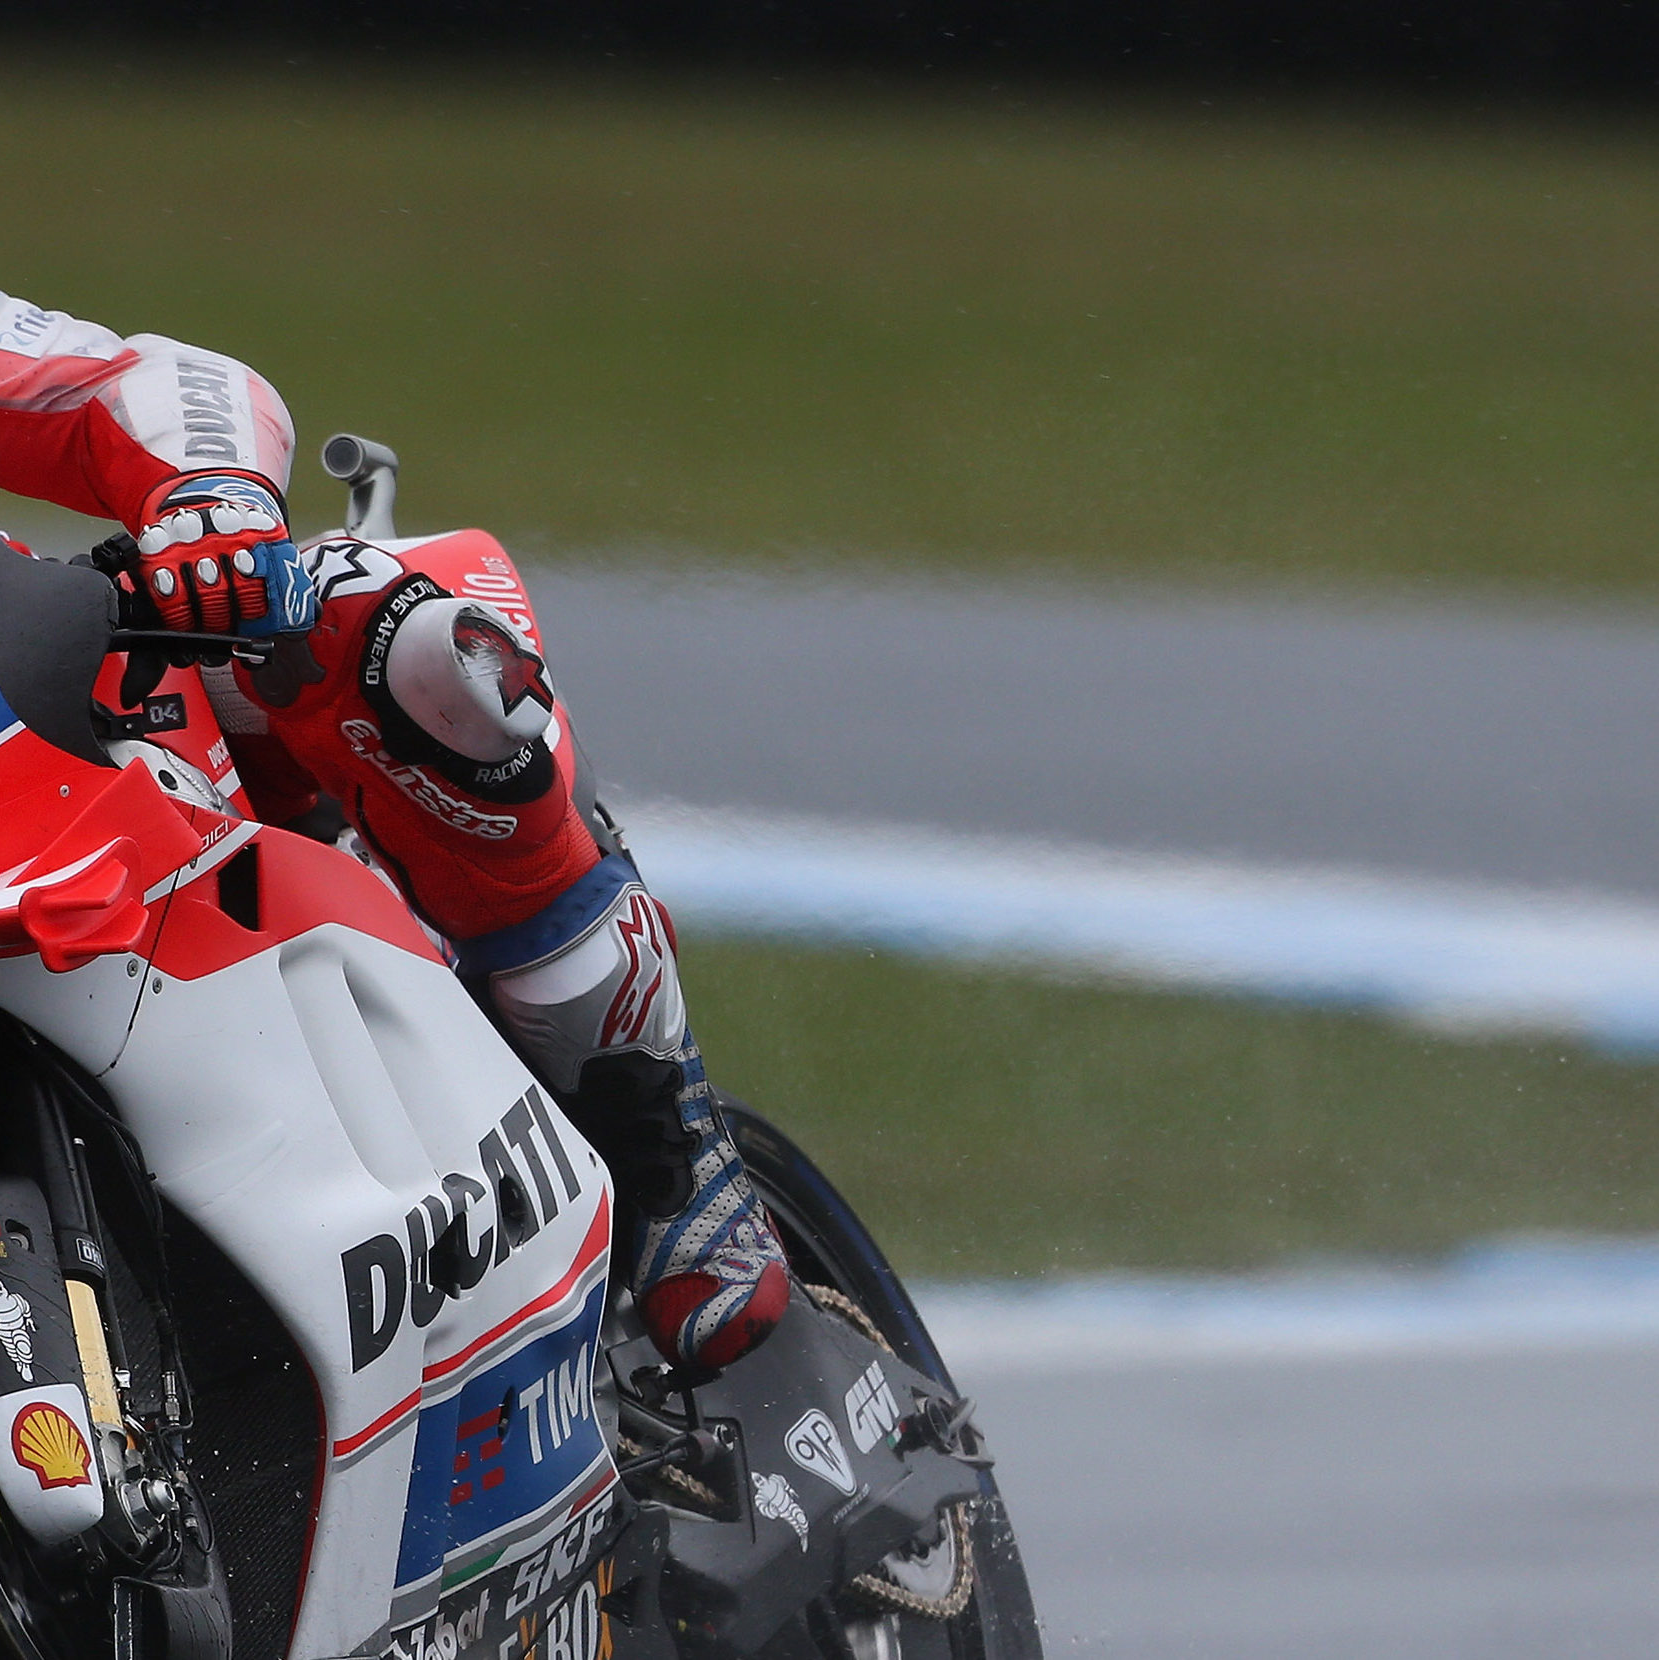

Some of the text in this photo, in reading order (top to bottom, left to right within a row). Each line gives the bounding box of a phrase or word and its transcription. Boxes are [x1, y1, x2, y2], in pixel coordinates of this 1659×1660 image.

[365, 613, 396, 686] AHEAD
[149, 702, 180, 724] 04
[475, 745, 533, 784] RACING
[340, 1082, 583, 1375] DUCATI
[518, 1342, 590, 1465] TIM
[505, 1490, 614, 1621] SKF
